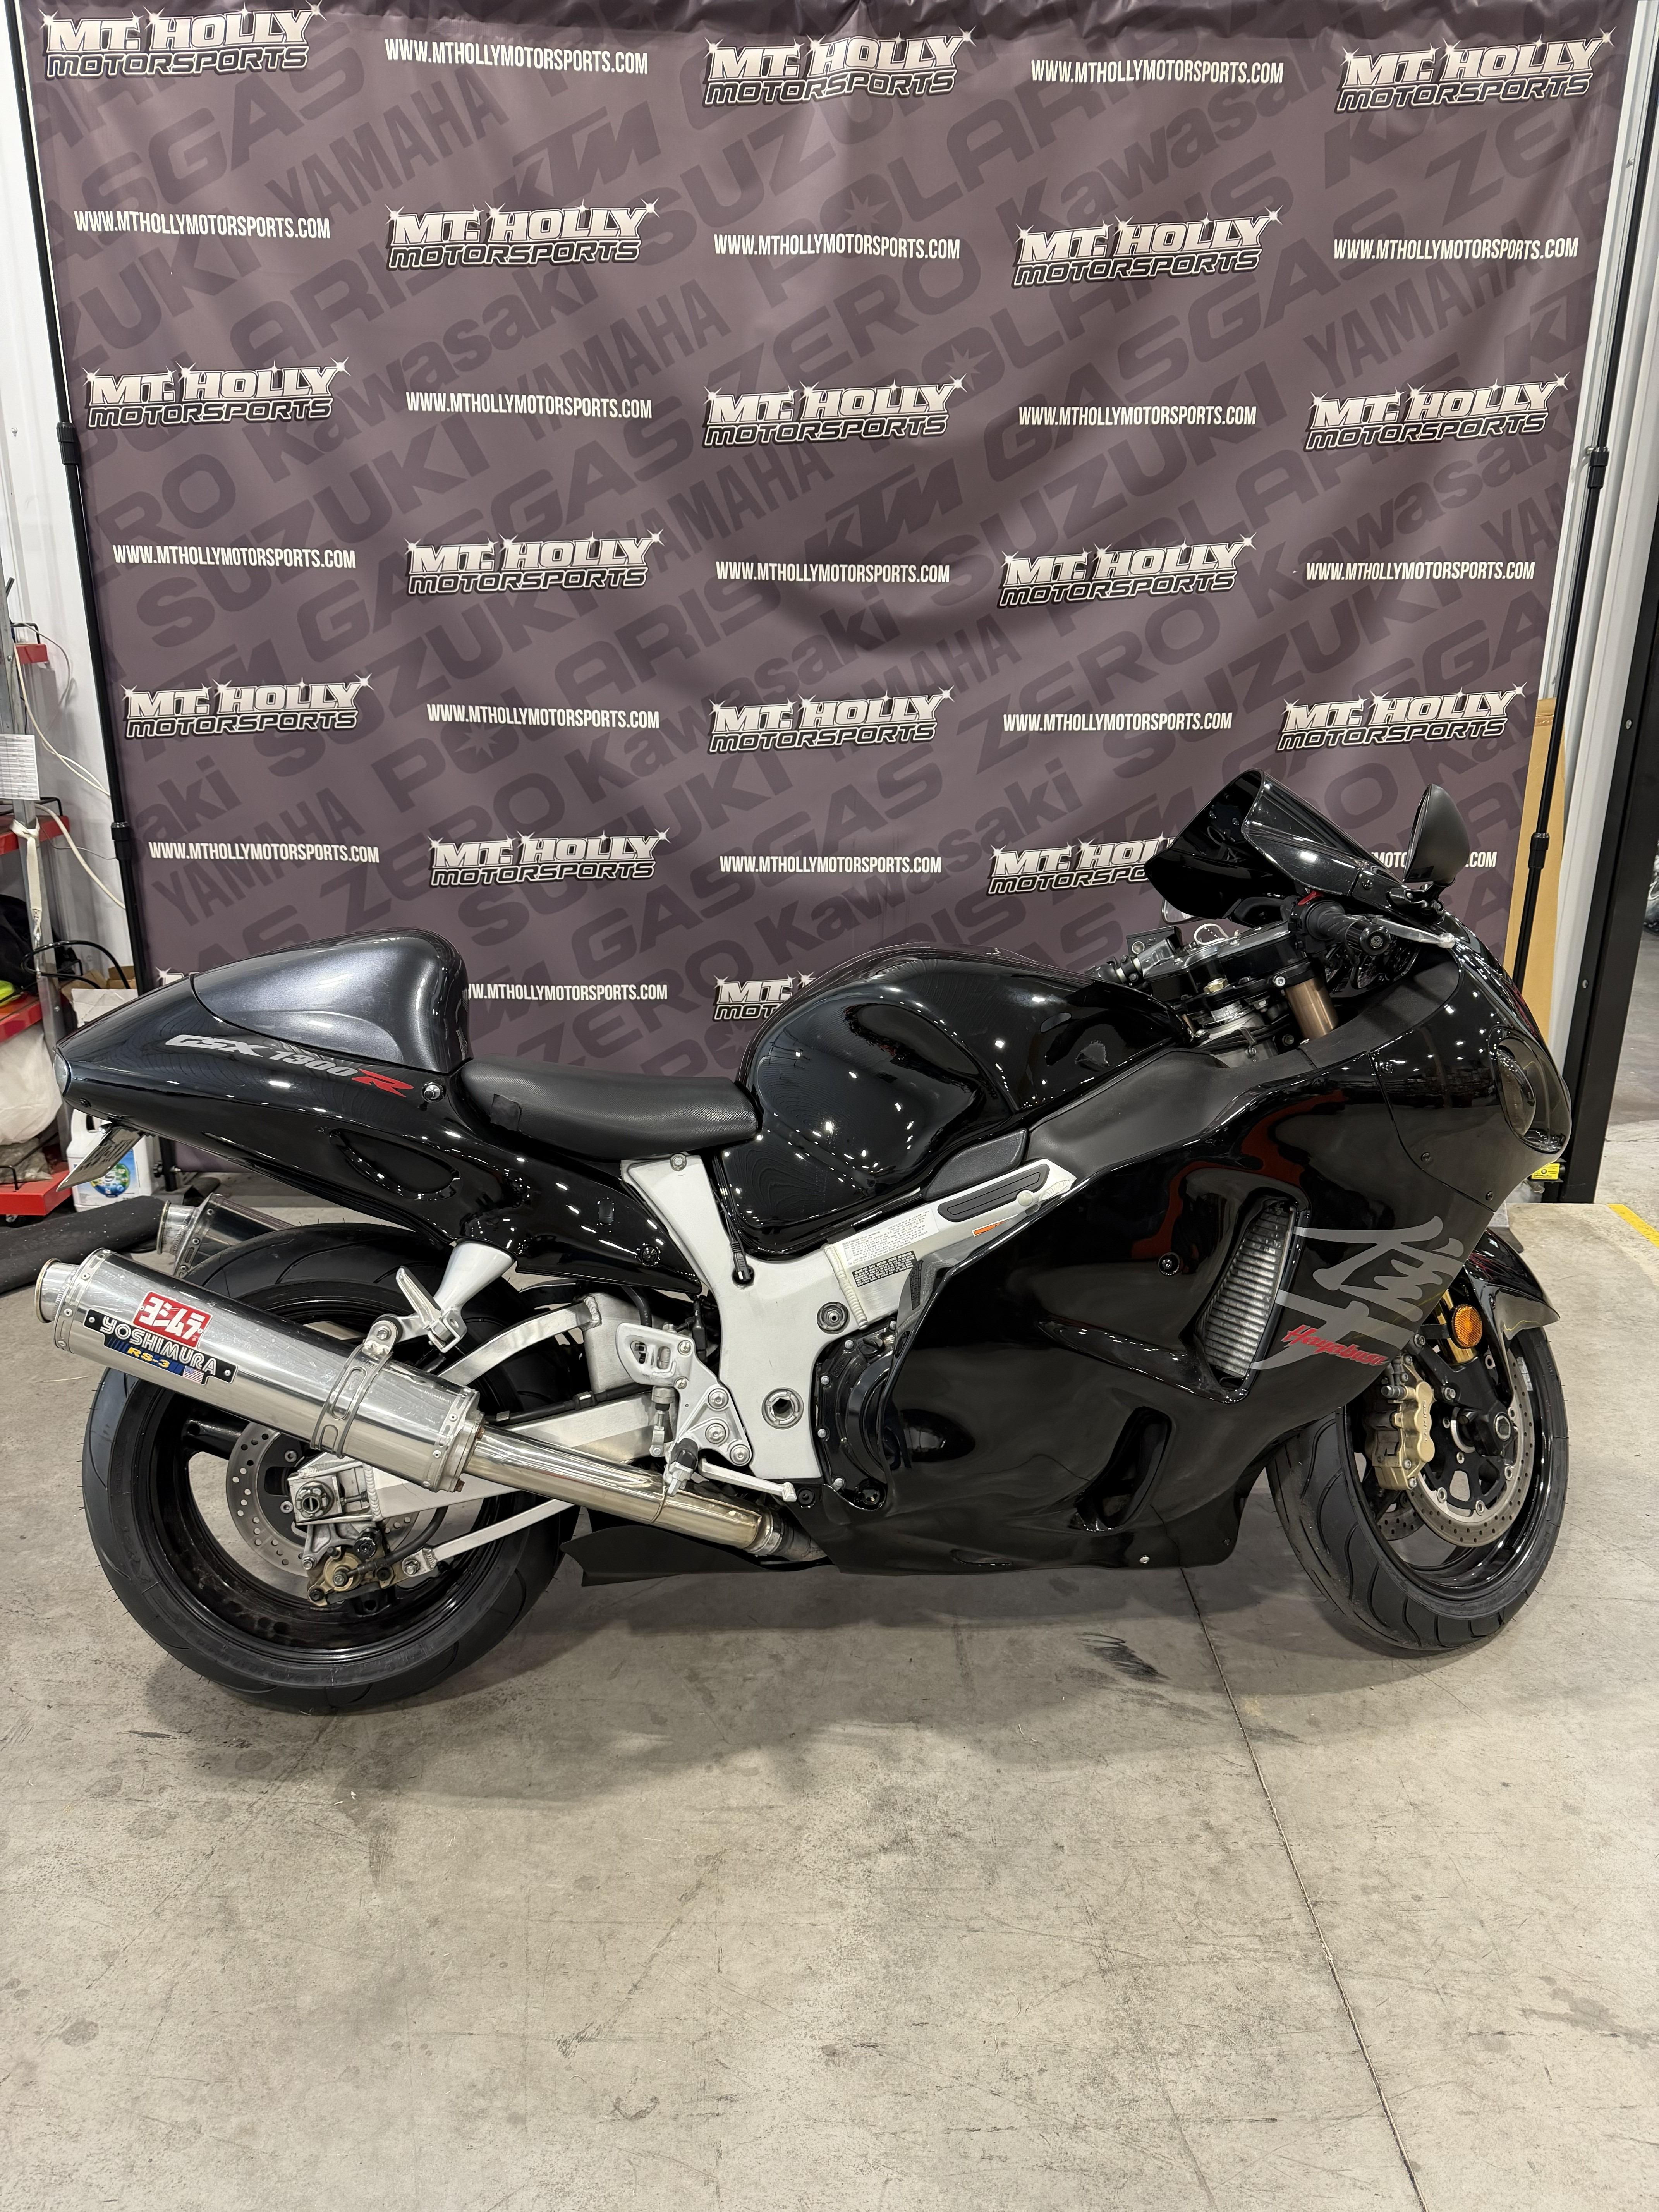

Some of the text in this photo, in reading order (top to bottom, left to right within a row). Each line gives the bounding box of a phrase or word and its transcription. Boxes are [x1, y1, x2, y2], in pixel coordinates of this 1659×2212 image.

[47, 10, 311, 53] MT. HOLLY
[47, 46, 309, 77] MOTORSPORTS
[385, 39, 648, 74] WWW.MTHOLLYMOTORSPORTS.COM
[709, 36, 963, 80] MT. HOLLY
[1031, 60, 1284, 83] WWW.MTHOLLYMOTORSPORTS.COM
[1344, 39, 1603, 87] MT. HOLLY
[705, 70, 957, 105] MOTORSPORTS
[1337, 73, 1592, 111] MOTORSPORTS
[74, 211, 330, 238] WWW.MTHOLLYMOTORSPORTS.COM
[391, 208, 648, 245] MT. HOLLY
[1017, 216, 1271, 263] MT. HOLLY
[390, 240, 642, 268] MOTORSPORTS
[714, 234, 960, 259] WWW.MTHOLLYMOTORSPORTS.COM
[1334, 238, 1579, 259] WWW.MTHOLLYMOTORSPORTS.COM
[1014, 249, 1262, 287] MOTORSPORTS
[89, 366, 338, 406] MT. HOLLY
[89, 398, 333, 427] MOTORSPORTS
[406, 392, 652, 418] WWW.MTHOLLYMOTORSPORTS.COM
[709, 384, 956, 423] MT. HOLLY
[1019, 406, 1256, 426] WWW.MTHOLLYMOTORSPORTS.COM
[1311, 381, 1560, 429] MT. HOLLY
[705, 414, 949, 446] MOTORSPORTS
[1306, 413, 1548, 450] MOTORSPORTS
[113, 545, 356, 568] WWW.MTHOLLYMOTORSPORTS.COM
[410, 538, 654, 574] MT. HOLLY
[1003, 543, 1246, 587] MT. HOLLY
[1307, 562, 1535, 580] WWW.MTHOLLYMOTORSPORTS.COM
[409, 567, 648, 594] MOTORSPORTS
[716, 562, 950, 583] WWW.MTHOLLYMOTORSPORTS.COM
[1000, 571, 1237, 606] MOTORSPORTS
[128, 682, 362, 718] MT. HOLLY
[427, 704, 659, 728] WWW.MTHOLLYMOTORSPORTS.COM
[713, 695, 946, 732] MT. HOLLY
[1284, 691, 1517, 732] MT. HOLLY
[127, 710, 358, 738] MOTORSPORTS
[709, 722, 937, 752] MOTORSPORTS
[1003, 713, 1232, 731] WWW.MTHOLLYMOTORSPORTS.COM
[1277, 718, 1507, 751] MOTORSPORTS
[149, 842, 379, 862] WWW.MTHOLLYMOTORSPORTS.COM
[434, 836, 661, 868] MT. HOLLY
[720, 856, 941, 873] WWW.MTHOLLYMOTORSPORTS.COM
[993, 838, 1176, 876] MT. HOL
[431, 862, 655, 886] MOTORSPORTS
[989, 865, 1149, 895] MOTORSPO
[468, 983, 667, 1001] W.MTHOLLYMOTORSPORTS.COM
[100, 1316, 217, 1376] YOSHIMURA
[127, 1346, 170, 1368] RS-3
[1280, 1324, 1390, 1366] Hayabusa
